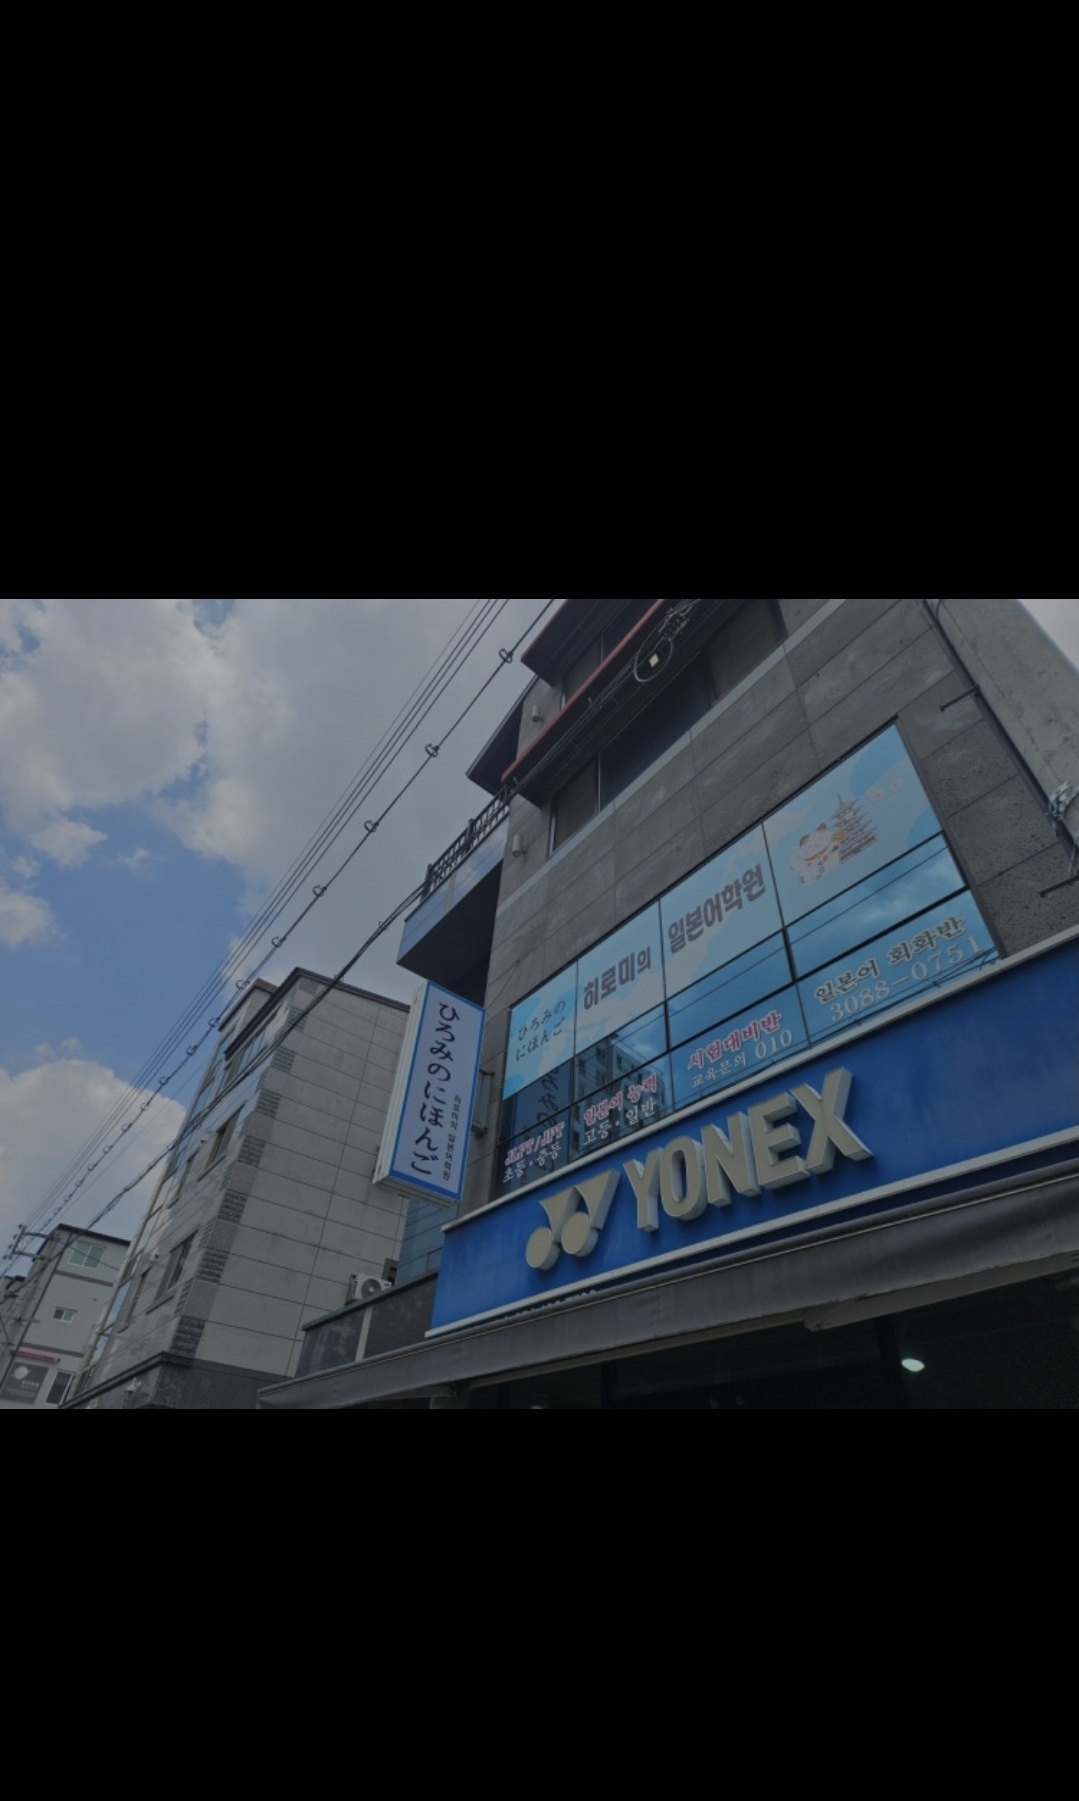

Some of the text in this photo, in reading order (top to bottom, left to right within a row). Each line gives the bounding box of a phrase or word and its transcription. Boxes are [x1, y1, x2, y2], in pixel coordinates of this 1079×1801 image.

[584, 863, 766, 1010] 히로미의 일본어학원
[692, 1052, 746, 1089] 교육문의
[755, 1029, 793, 1059] 010
[830, 935, 984, 1022] 3088-0751
[410, 1002, 460, 1176] ひろみのにほんご
[504, 1121, 565, 1166] JLPT/JPT
[583, 1090, 624, 1127] 일본어
[627, 1073, 657, 1104] 능력
[687, 1009, 782, 1070] 시험대비반
[814, 958, 880, 1004] 일본어
[887, 915, 966, 967] 회화반
[515, 1017, 565, 1061] にほんご
[517, 1000, 566, 1041] ひろみの
[623, 1066, 873, 1232] YONEX
